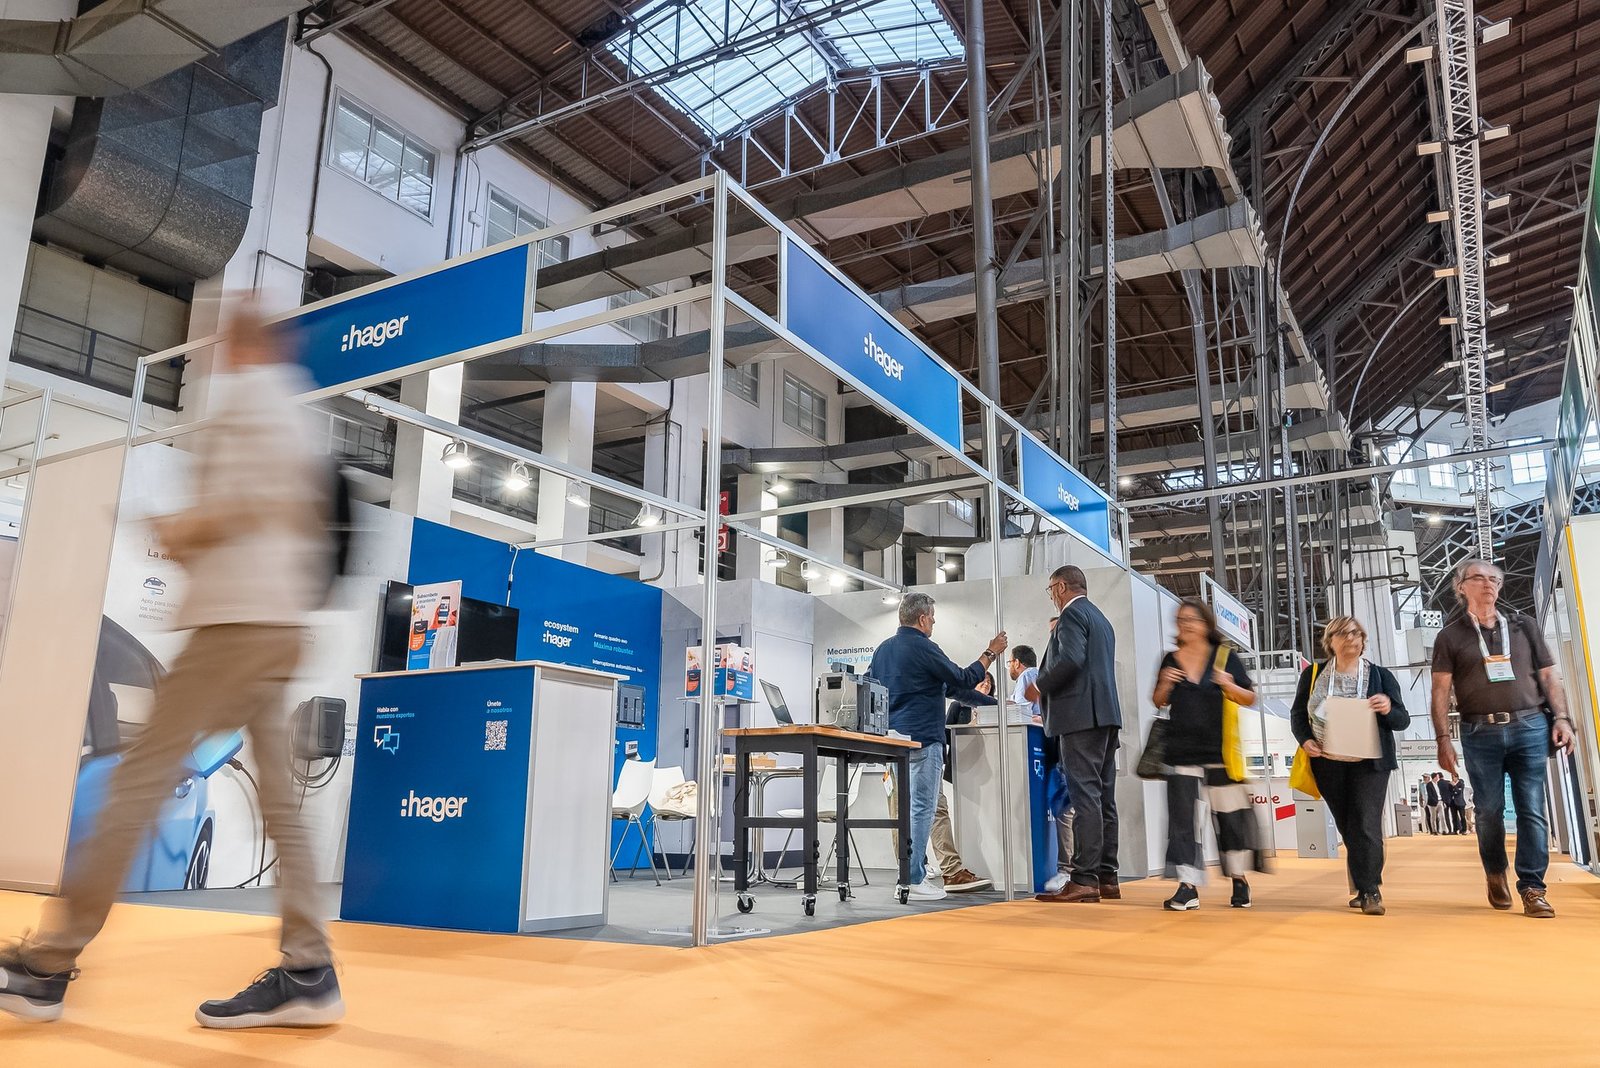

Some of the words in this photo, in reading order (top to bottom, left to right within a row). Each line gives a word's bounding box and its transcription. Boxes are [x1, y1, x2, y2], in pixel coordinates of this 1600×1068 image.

[341, 315, 409, 352] :hager
[864, 332, 904, 381] :hager
[1058, 482, 1080, 511] :hager
[147, 548, 159, 558] La
[543, 620, 579, 633] ecosystem
[542, 630, 572, 648] :hager
[826, 646, 874, 656] Mecanismos
[400, 790, 468, 823] :hager
